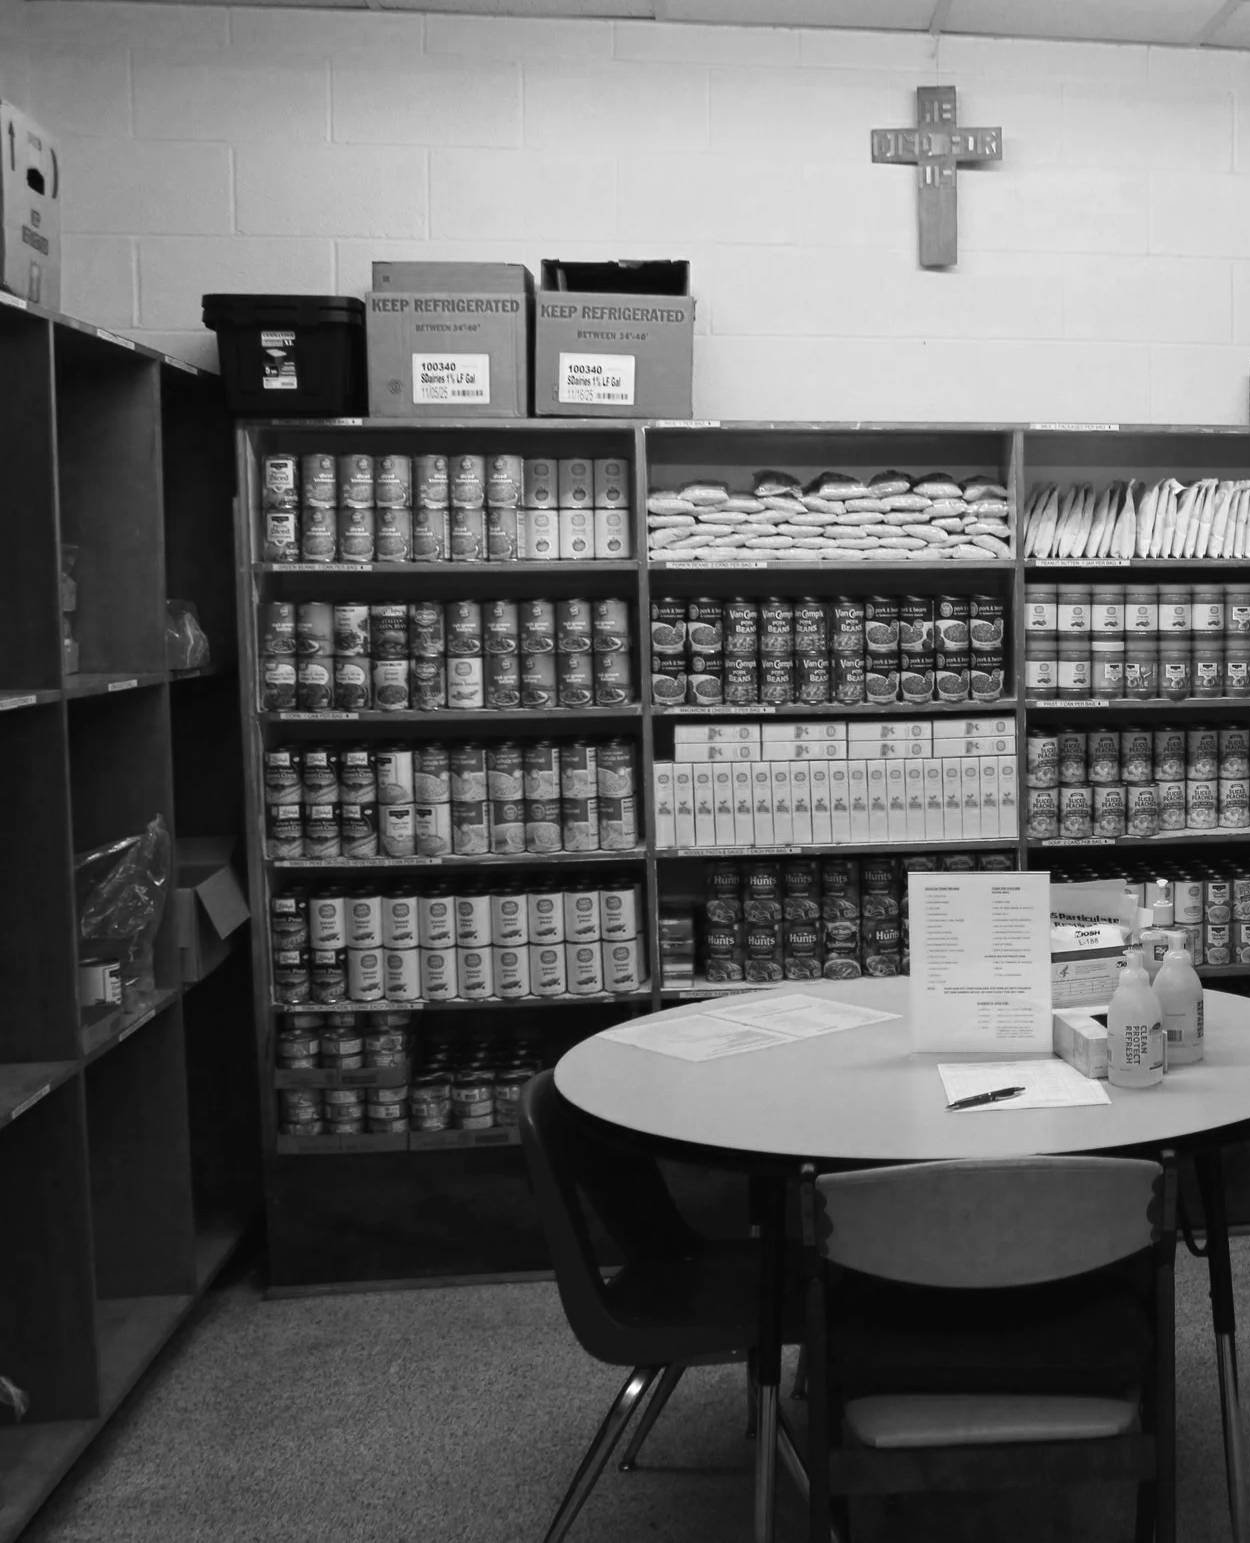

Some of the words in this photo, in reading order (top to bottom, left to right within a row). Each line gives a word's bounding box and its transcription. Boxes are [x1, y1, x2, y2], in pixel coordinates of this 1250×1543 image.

[371, 299, 410, 313] KEEP
[414, 299, 521, 313] REFRIGERATED
[540, 304, 579, 319] KEEP
[582, 305, 686, 323] REFRIGERATED
[416, 324, 451, 333] BETWEEN
[577, 330, 617, 341] BETWEEN
[421, 363, 456, 372] 100340
[568, 365, 603, 375] 100340
[1058, 913, 1120, 924] Particulate
[1132, 1025, 1140, 1066] PROTECT
